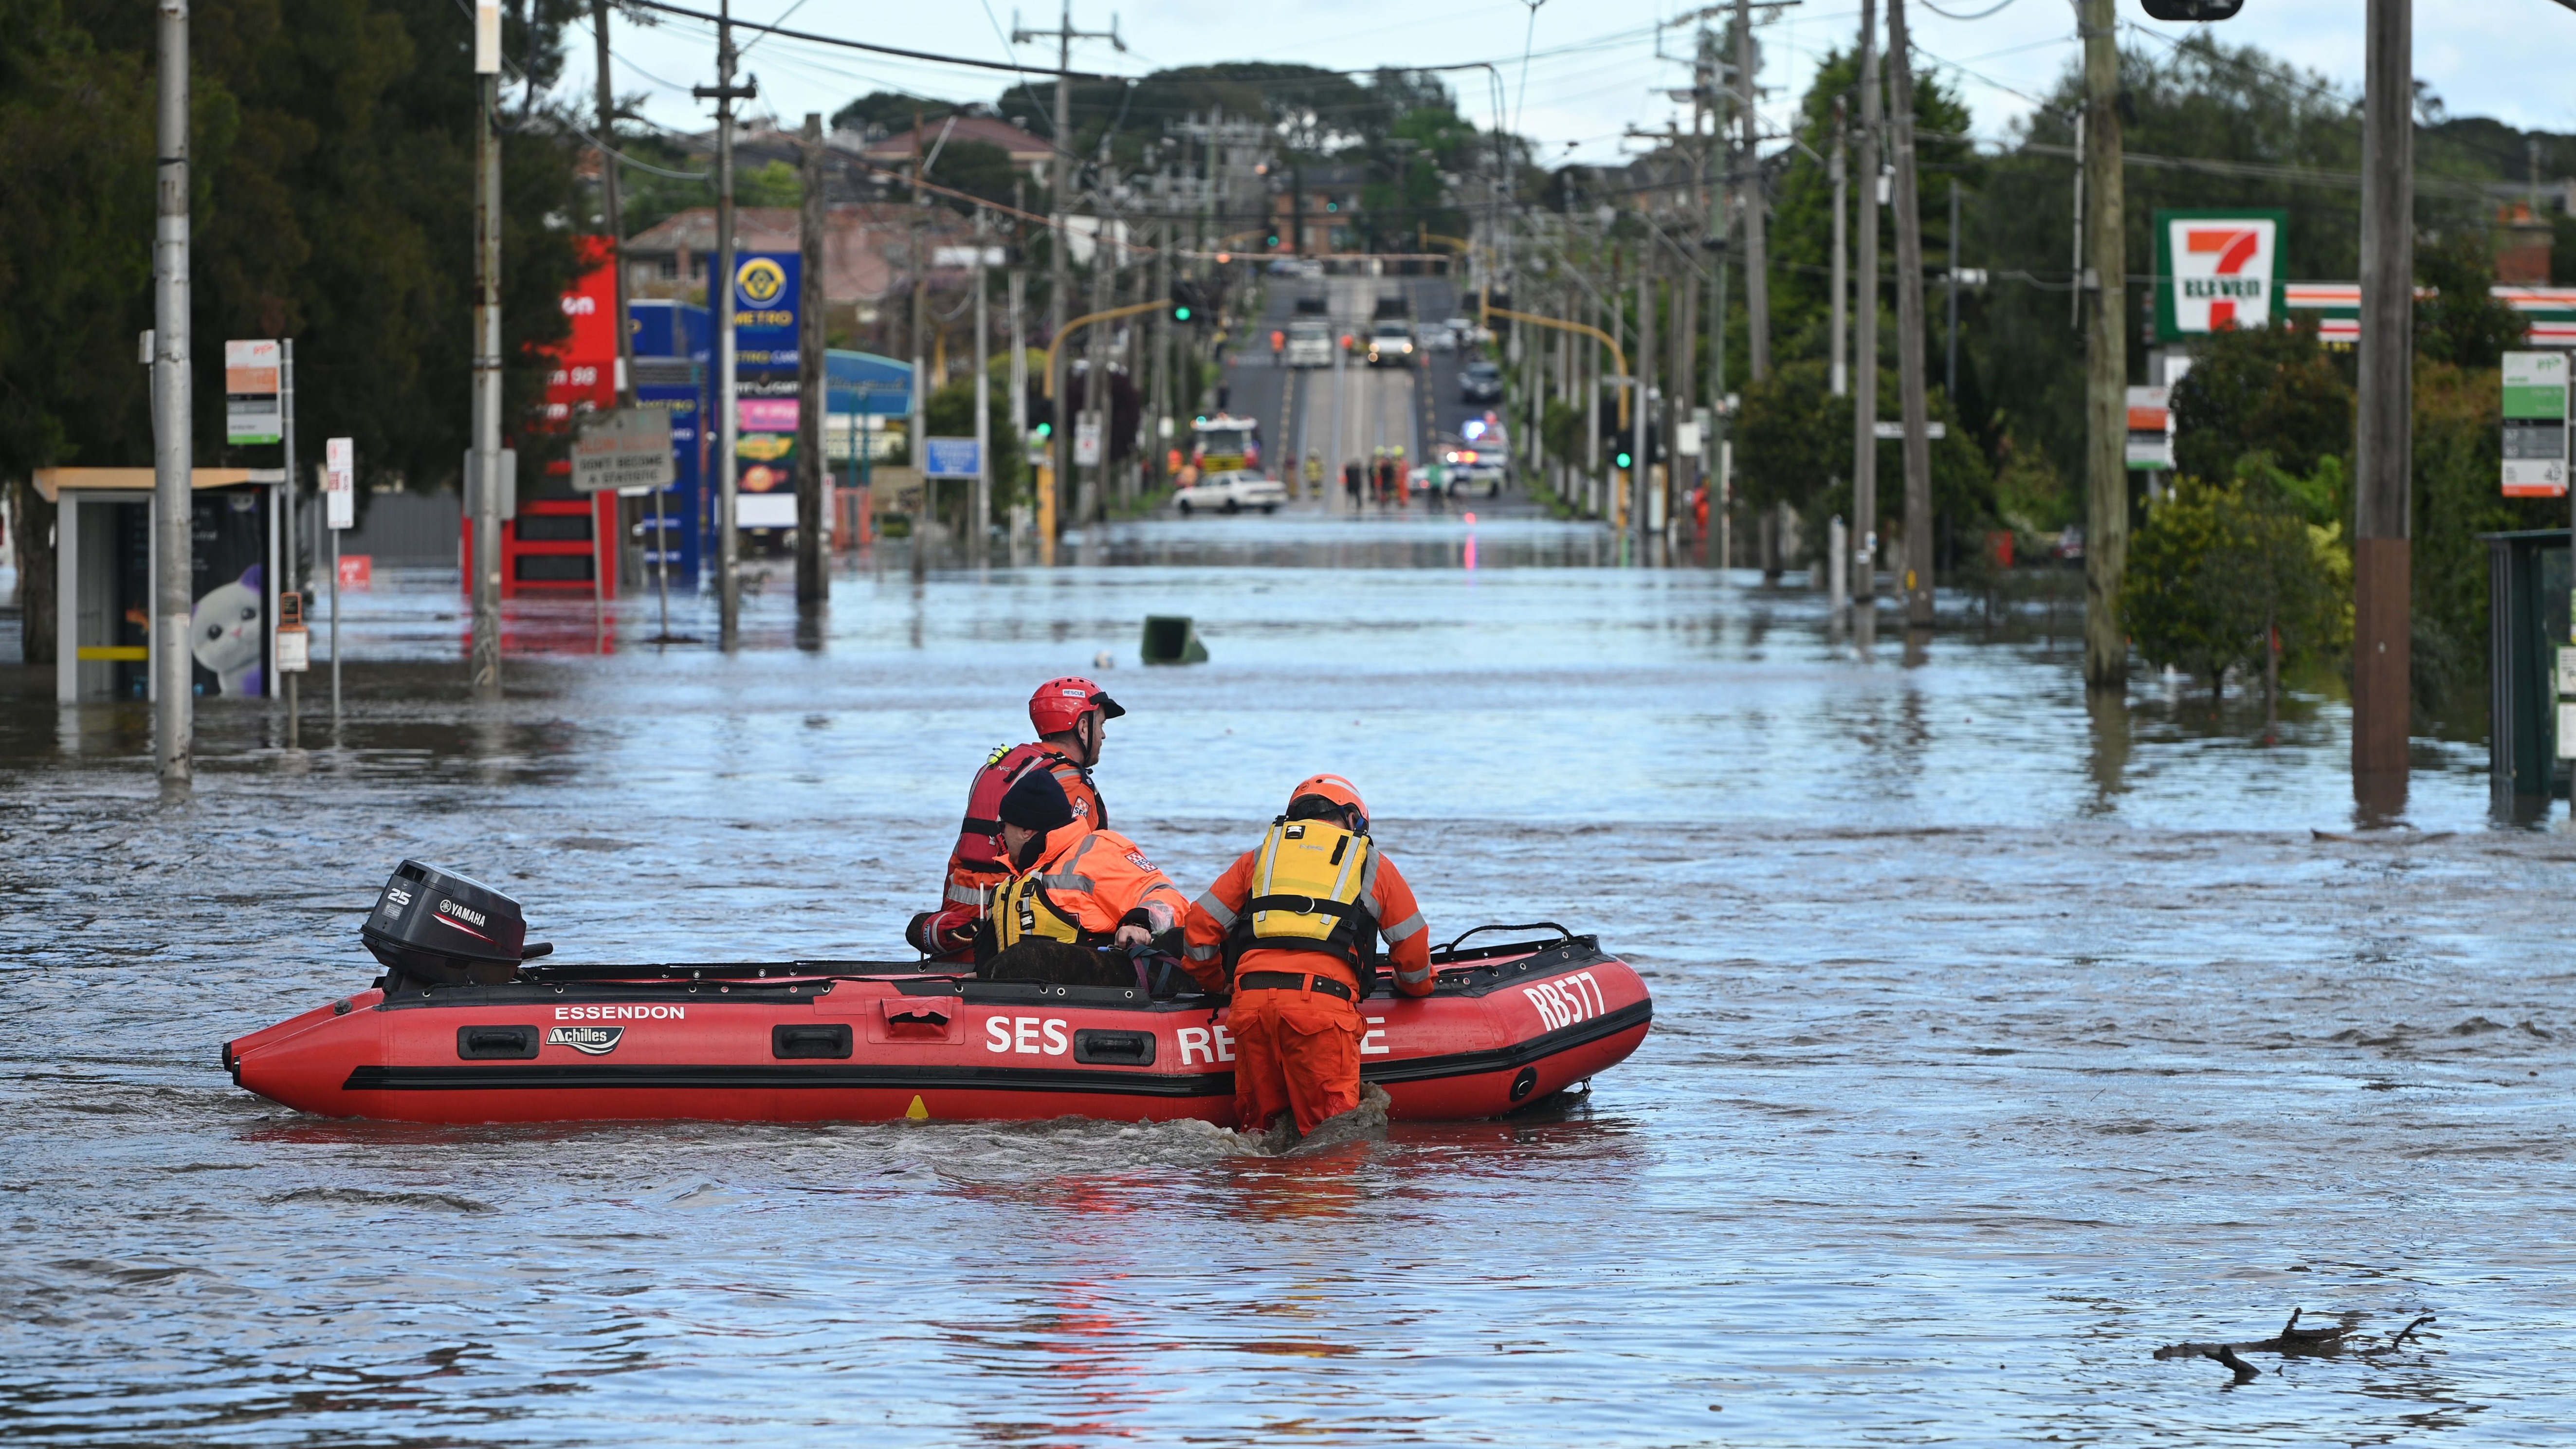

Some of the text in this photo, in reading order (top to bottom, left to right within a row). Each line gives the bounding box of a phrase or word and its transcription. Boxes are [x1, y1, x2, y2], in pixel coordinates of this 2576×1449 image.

[387, 888, 412, 906] 25
[451, 903, 486, 927] YAMAHA
[1522, 972, 1605, 1032] RB577
[555, 1006, 684, 1020] ESSENDON
[549, 1027, 607, 1042] Achilles
[986, 1016, 1068, 1056] SES
